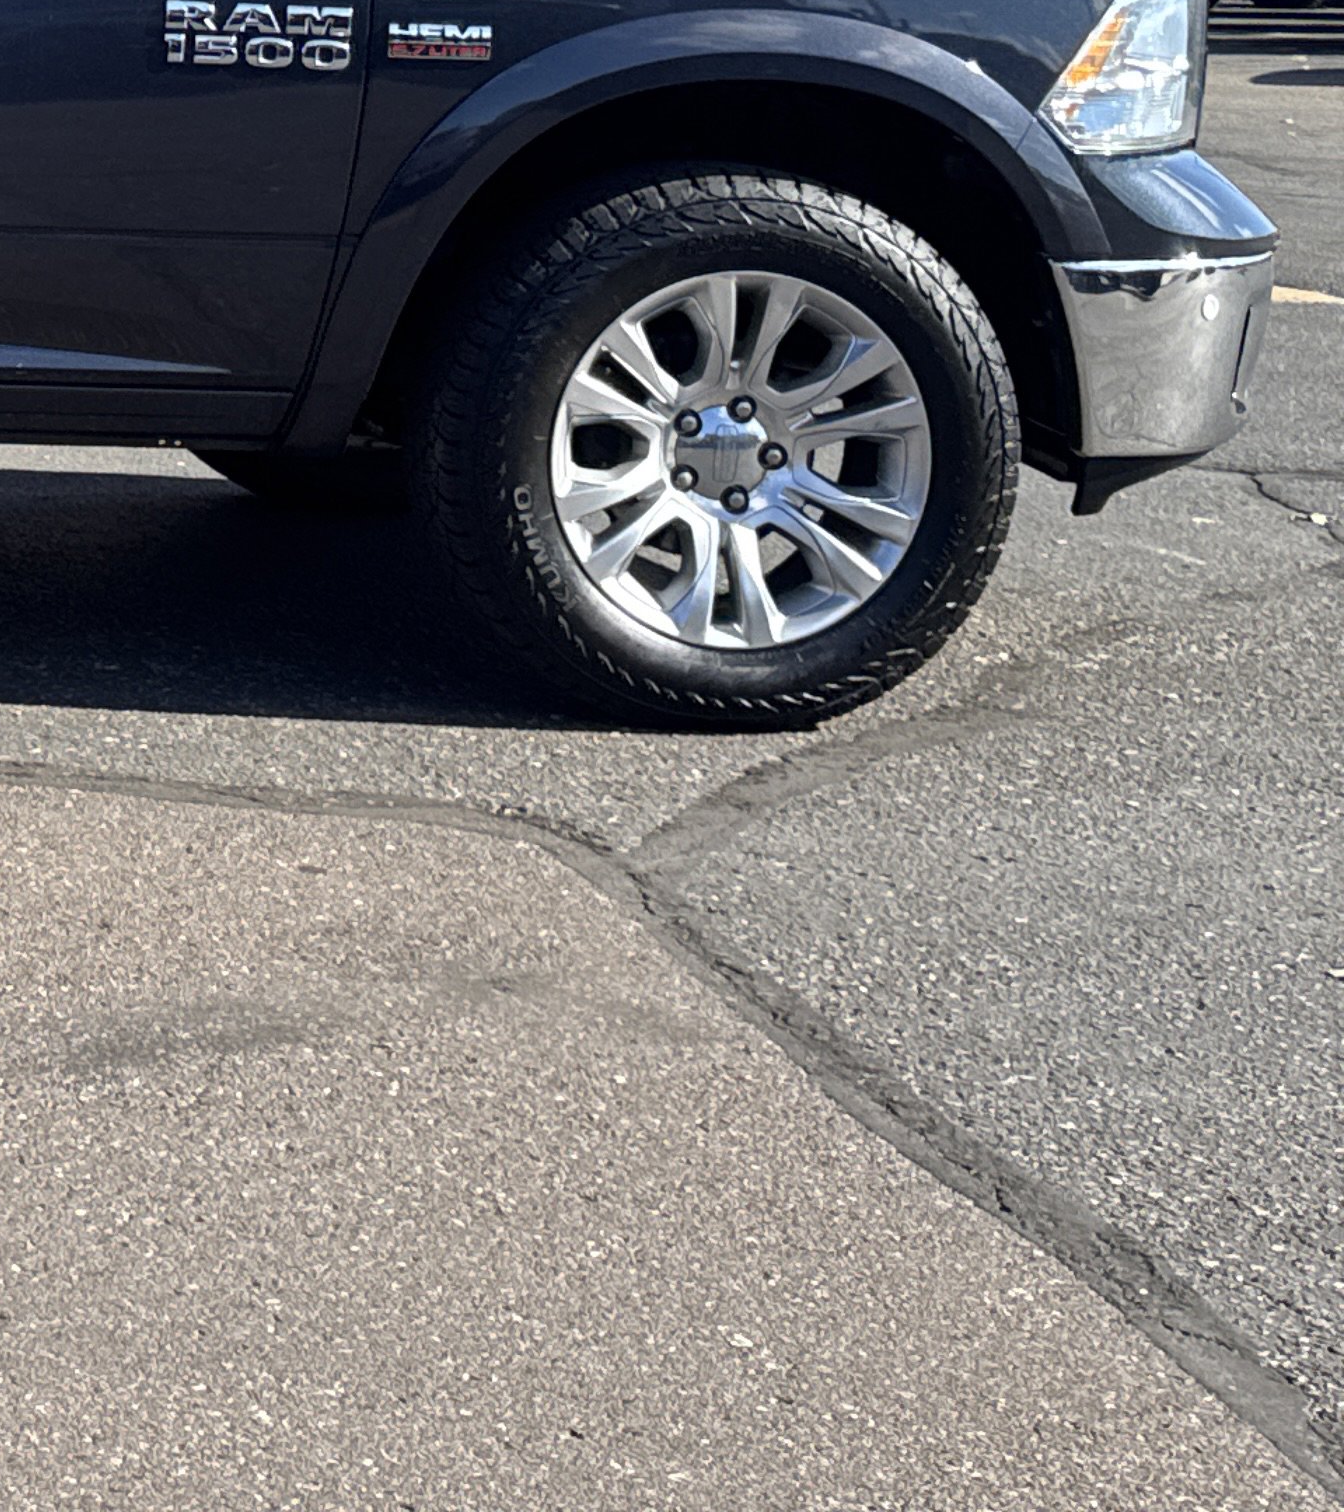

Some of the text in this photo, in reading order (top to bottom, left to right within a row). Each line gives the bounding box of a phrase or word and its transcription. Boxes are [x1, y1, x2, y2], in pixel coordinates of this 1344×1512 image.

[165, 0, 354, 37] RAM
[388, 23, 492, 40] HEMI
[164, 33, 352, 71] 1500
[513, 483, 583, 612] KUMHO
